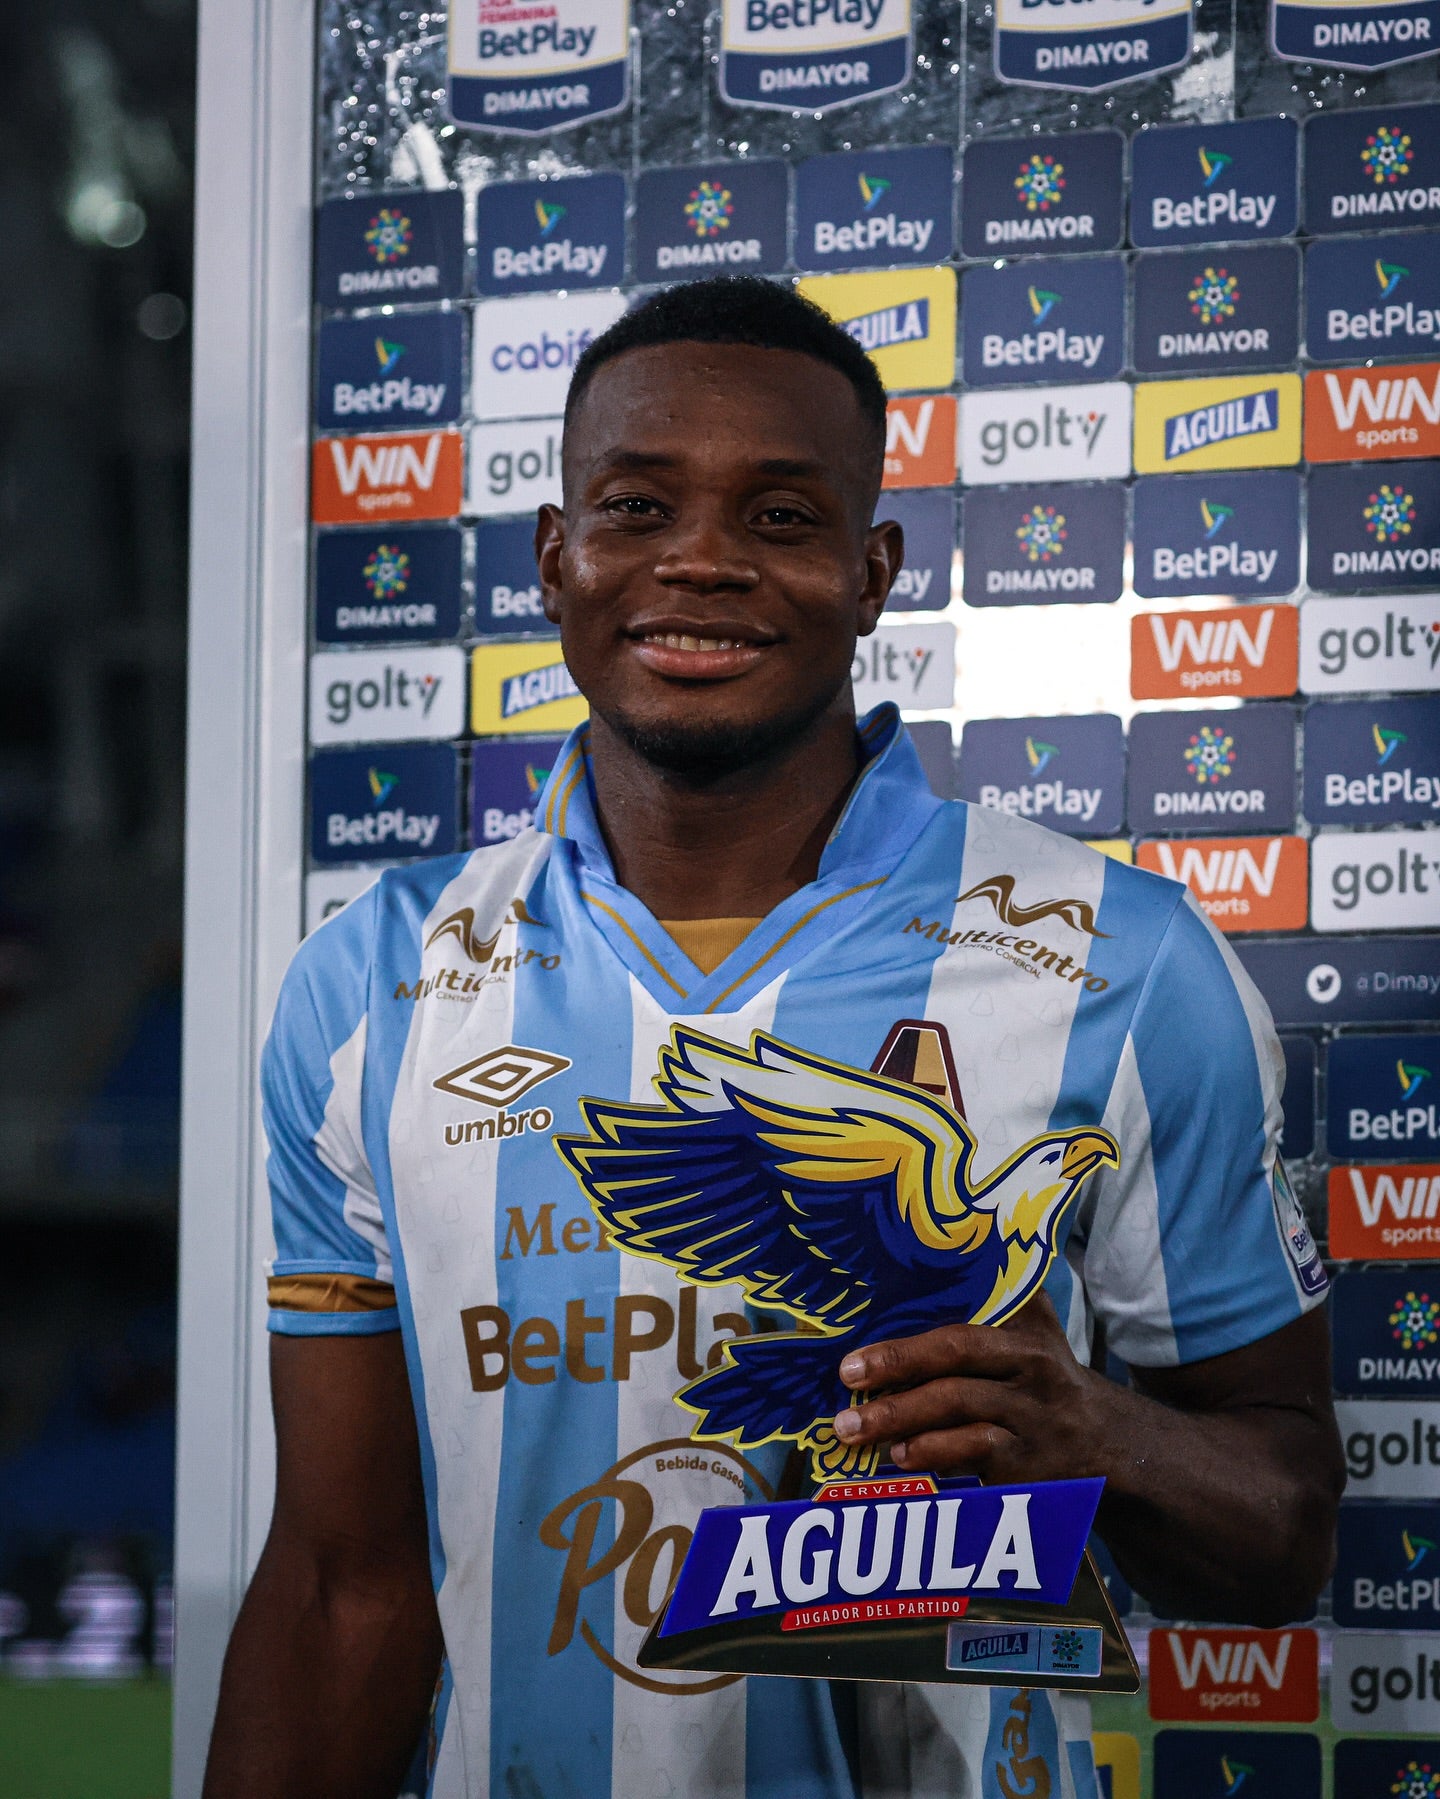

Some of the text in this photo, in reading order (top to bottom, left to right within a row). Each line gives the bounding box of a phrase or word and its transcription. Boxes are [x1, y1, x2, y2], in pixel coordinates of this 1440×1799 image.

[746, 0, 884, 31] BetPlay
[1314, 17, 1431, 47] DIMAYOR
[479, 21, 597, 58] BetPlay
[1036, 39, 1149, 71] DIMAYOR
[760, 62, 870, 92] DIMAYOR
[483, 84, 590, 115] DIMAYOR
[1152, 189, 1276, 229] BetPlay
[1331, 187, 1440, 218] DIMAYOR
[814, 213, 934, 253] BetPlay
[985, 215, 1094, 244] DIMAYOR
[493, 240, 608, 278] BetPlay
[657, 240, 761, 269] DIMAYOR
[339, 266, 439, 296] DIMAYOR
[846, 302, 923, 348] GUILA
[1158, 328, 1269, 357] DIMAYOR
[982, 328, 1104, 367] BetPlay
[333, 378, 446, 415] BetPlay
[1324, 373, 1440, 431] WIN
[981, 404, 1106, 465] golty
[1169, 395, 1271, 456] AGUILA
[1356, 427, 1419, 449] sports
[331, 434, 440, 495] WIN
[1152, 542, 1277, 582] BetPlay
[1333, 548, 1440, 575] DIMAYOR
[986, 567, 1095, 594] DIMAYOR
[336, 604, 436, 629] DIMAYOR
[1151, 610, 1274, 671] WIN
[851, 639, 934, 693] olty
[1180, 668, 1242, 690] sports
[326, 665, 441, 723] golty
[505, 664, 580, 716] AGUIL
[979, 781, 1102, 821] BetPlay
[1154, 790, 1265, 815] DIMAYOR
[327, 808, 440, 846] BetPlay
[1156, 838, 1282, 896] WIN
[1332, 848, 1440, 911] golt
[1199, 897, 1250, 916] ports
[902, 917, 1109, 992] Multicentro
[393, 948, 561, 1001] Multicntro
[444, 1108, 553, 1147] umbro
[1349, 1104, 1440, 1140] BetPl
[460, 1286, 755, 1392] BetPla
[1359, 1357, 1440, 1380] DIMAY
[656, 1456, 708, 1472] Bebida
[829, 1482, 926, 1498] CERVEZA
[709, 1494, 1042, 1617] AGUILA
[796, 1601, 960, 1626] JUGADOR DEL PARTIDO
[966, 1634, 1024, 1660] AGUILA
[1168, 1633, 1292, 1690] WIN
[1199, 1689, 1261, 1707] sports
